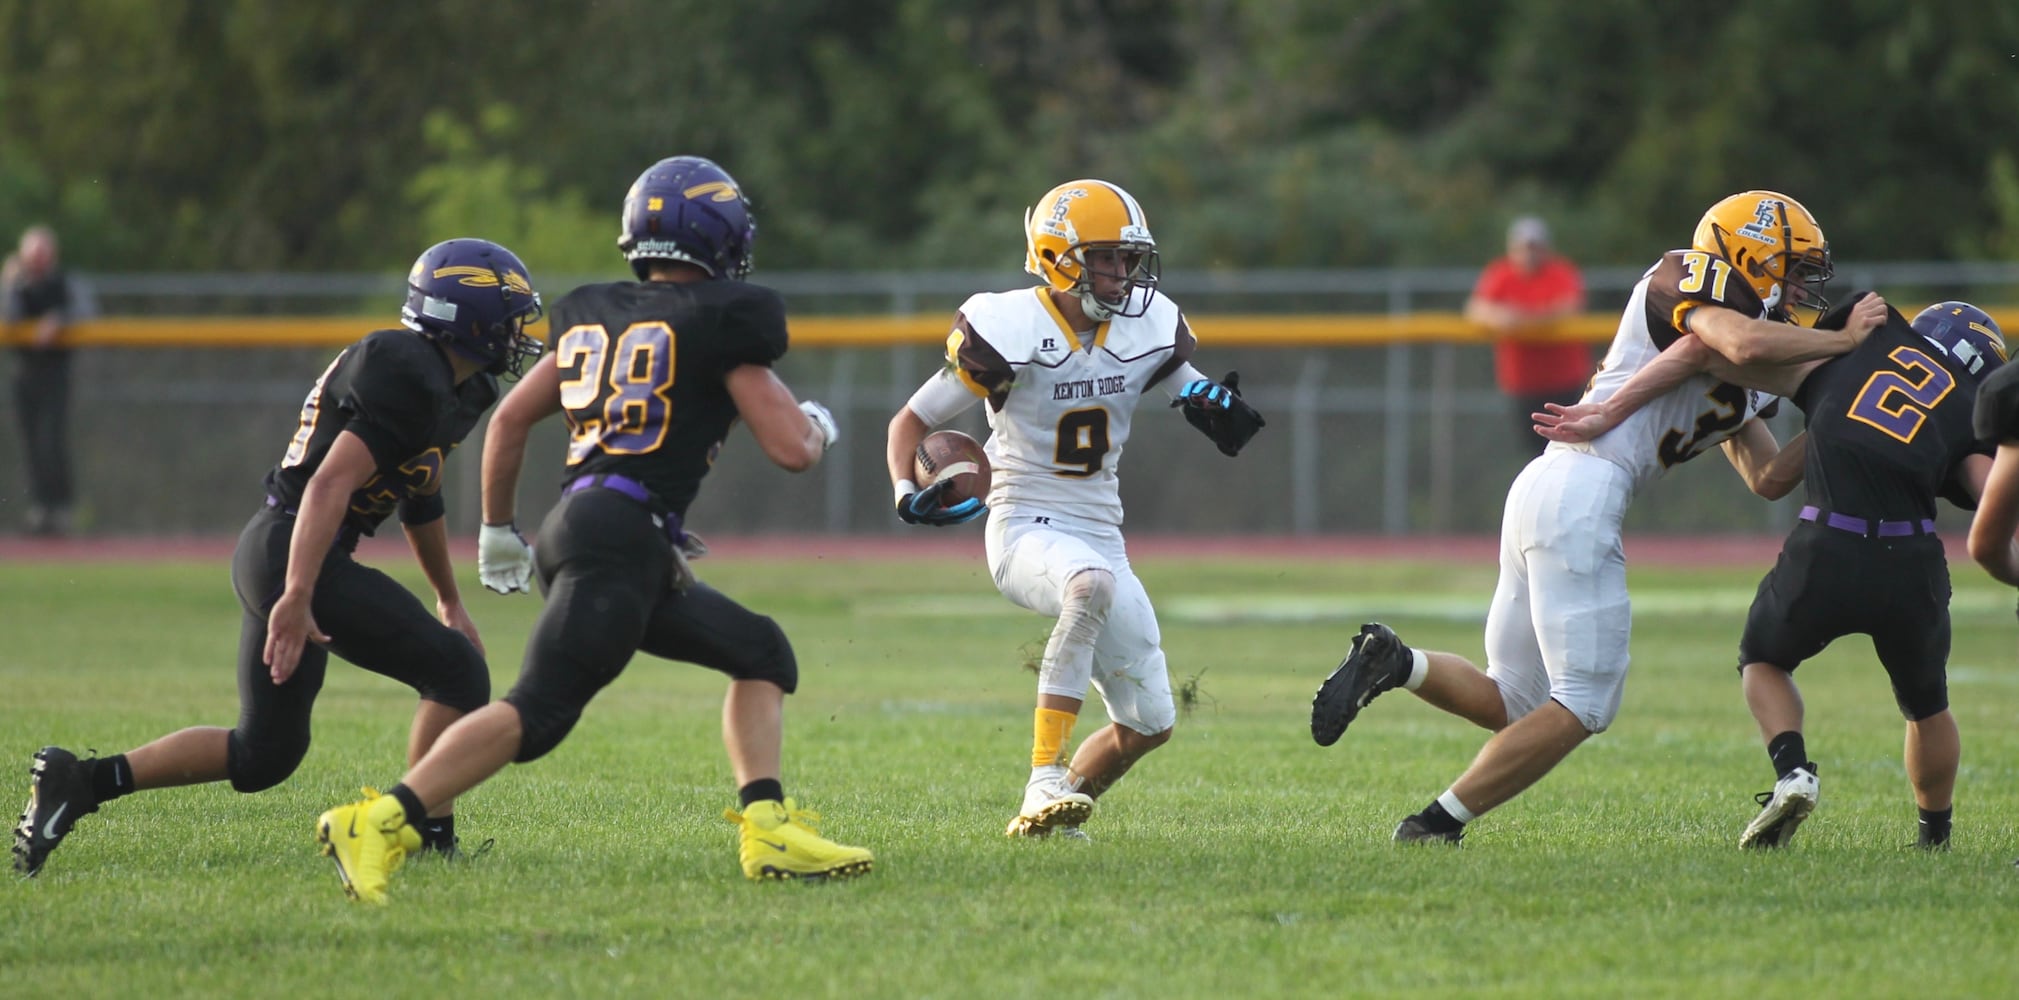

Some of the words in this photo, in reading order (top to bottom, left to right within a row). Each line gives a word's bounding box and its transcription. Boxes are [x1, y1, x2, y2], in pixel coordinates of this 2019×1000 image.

[637, 237, 677, 251] schutt
[1737, 229, 1776, 245] COUGARS
[1680, 252, 1732, 302] 31
[556, 320, 677, 466] 28
[1053, 379, 1094, 400] KENTON
[1098, 375, 1125, 396] RIDGE
[1846, 345, 1956, 444] 2
[1053, 405, 1110, 479] 9
